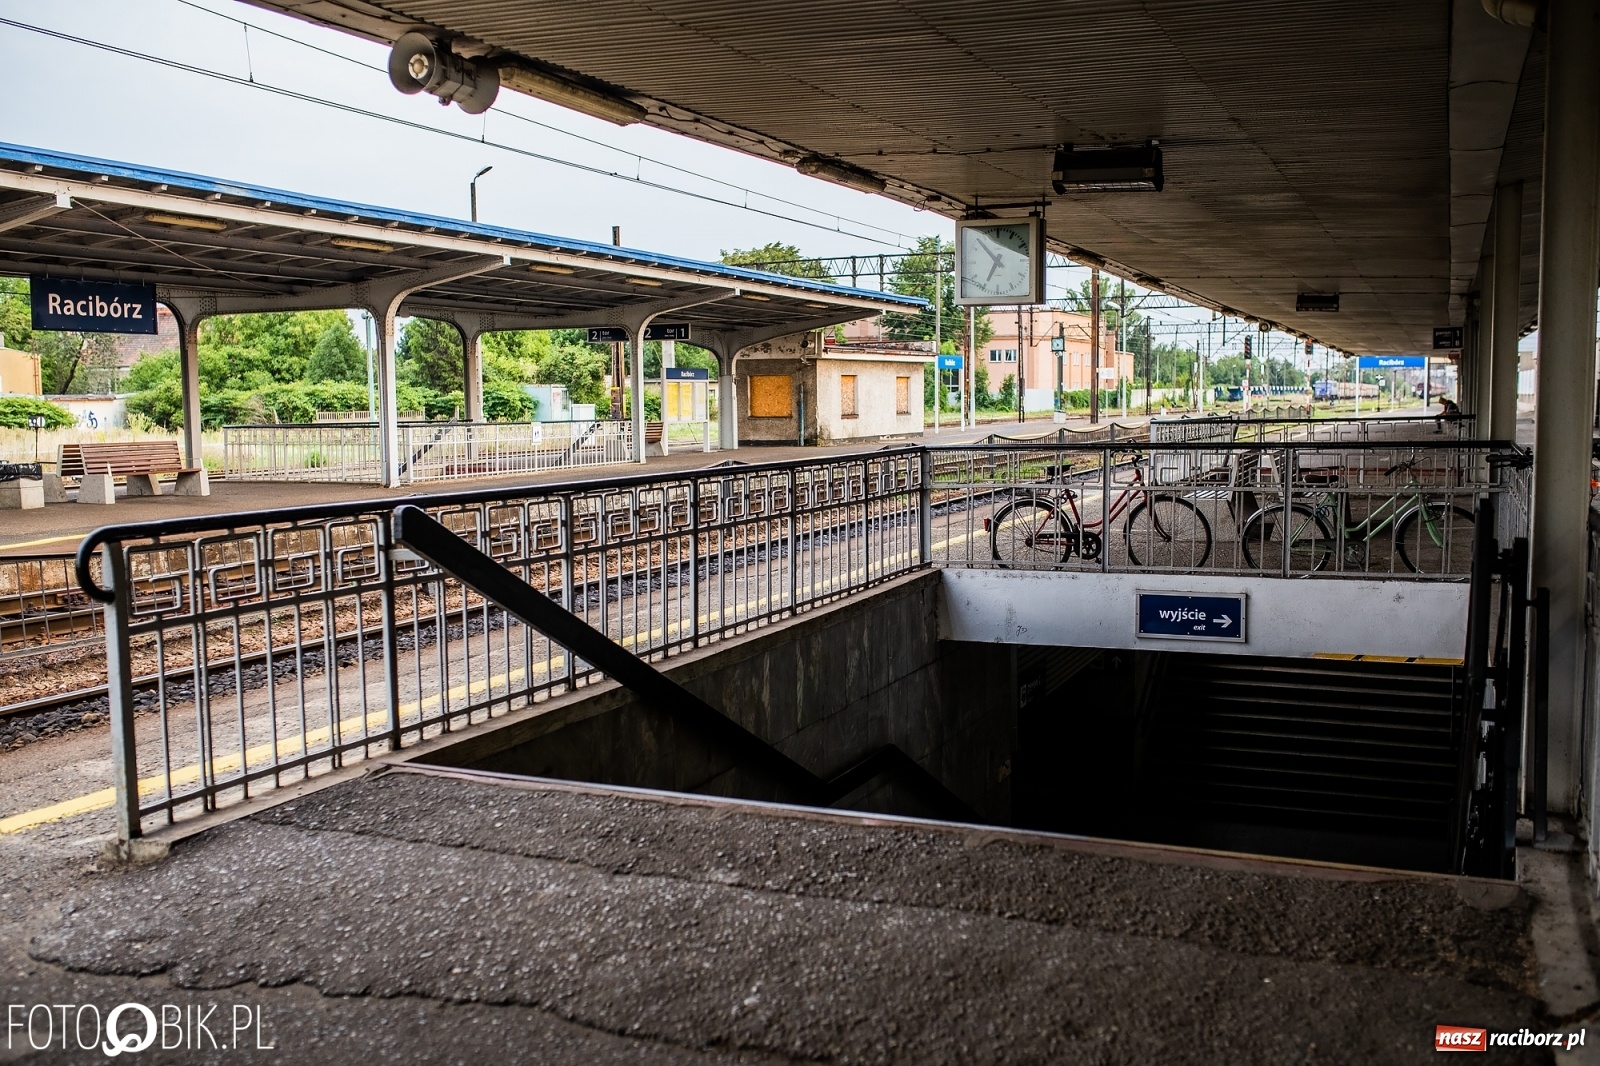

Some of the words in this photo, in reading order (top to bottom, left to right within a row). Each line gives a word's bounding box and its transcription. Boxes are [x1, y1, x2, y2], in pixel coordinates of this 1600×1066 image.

[47, 292, 143, 319] Racibórz
[592, 331, 598, 340] 2
[644, 328, 652, 338] 2
[680, 328, 685, 338] 1
[1159, 608, 1207, 622] wyjście
